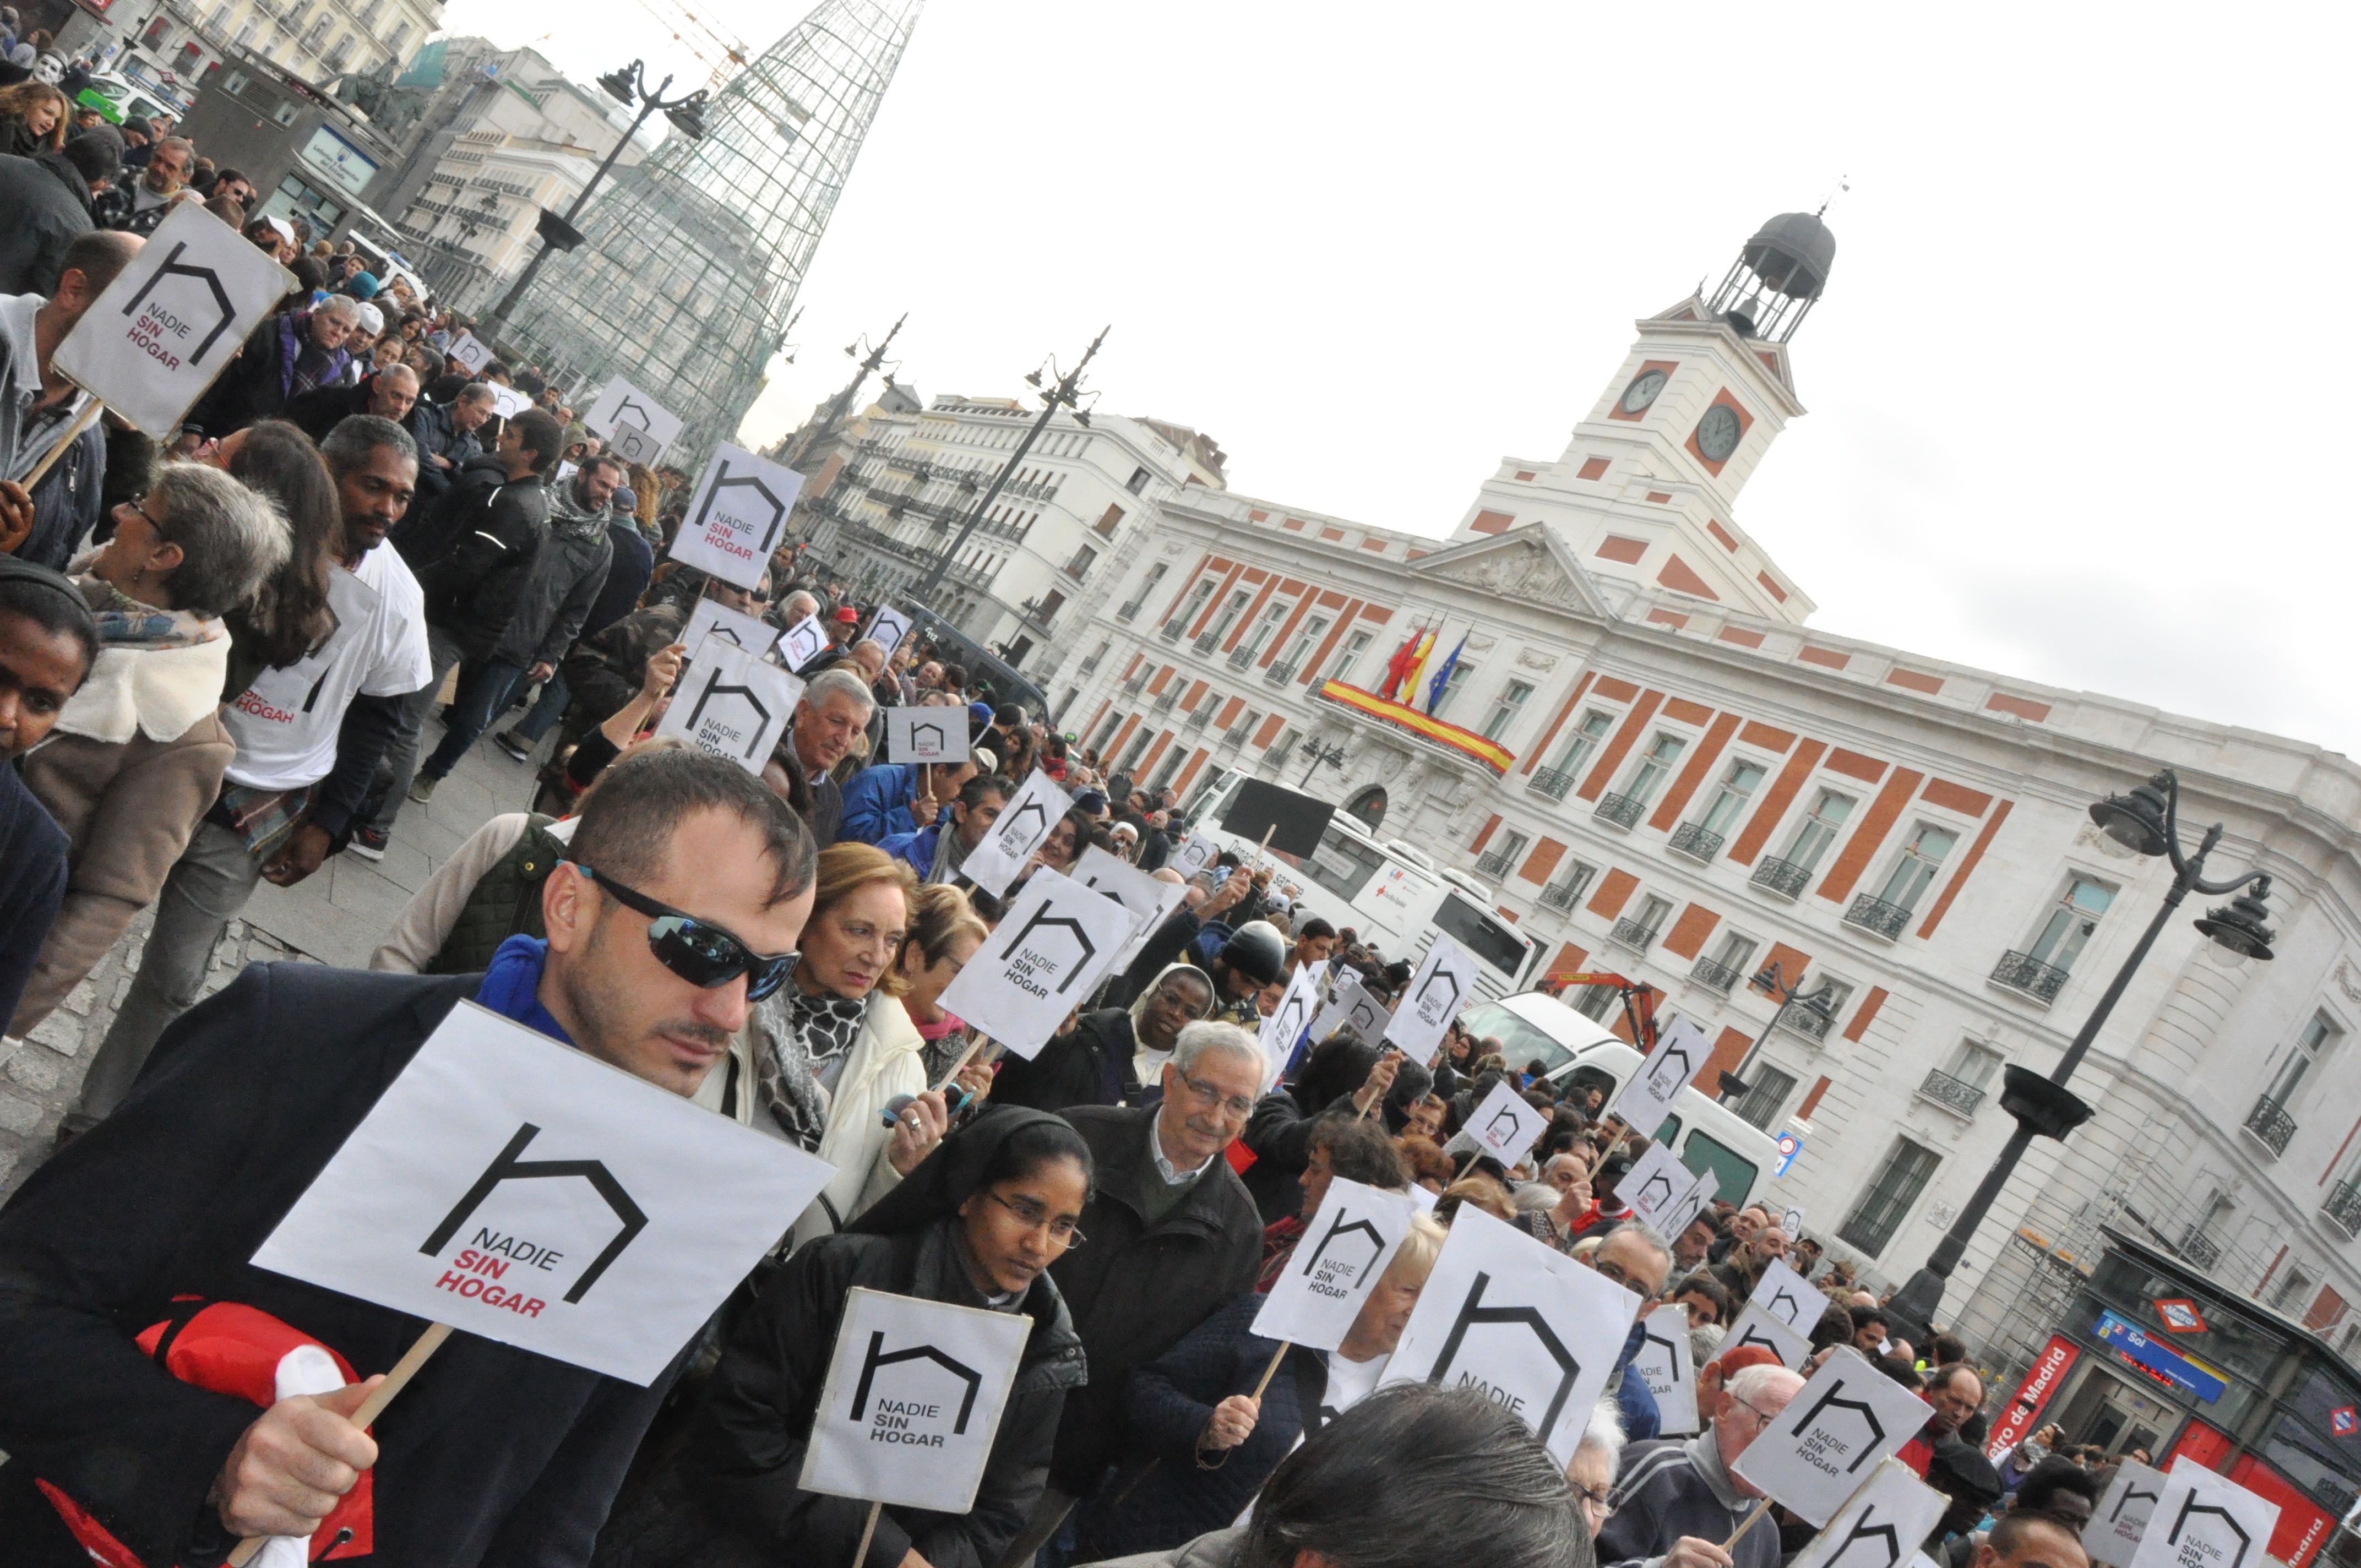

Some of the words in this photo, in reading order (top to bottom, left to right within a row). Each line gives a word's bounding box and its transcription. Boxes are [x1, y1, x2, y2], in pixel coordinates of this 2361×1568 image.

[137, 315, 164, 338] SIN
[146, 302, 191, 339] NADIE
[126, 327, 180, 371] HOGAR
[710, 522, 733, 538] SIN
[714, 511, 755, 535] NADIE
[704, 532, 753, 560] HOGAR
[699, 728, 721, 745] SIN
[704, 717, 742, 743] NADIE
[1003, 834, 1015, 846] SIN
[1011, 826, 1028, 843] NADIE
[998, 842, 1018, 861] HOGAR
[1012, 959, 1035, 976] SIN
[1020, 948, 1058, 974] NADIE
[1004, 968, 1048, 1000] HOGAR
[1421, 1001, 1432, 1012] SIN
[1424, 993, 1443, 1011] NADIE
[1417, 1009, 1437, 1028] HOGAR
[1652, 1079, 1662, 1089] SIN
[1647, 1085, 1665, 1104] HOGAR
[1486, 1135, 1500, 1149] HOGAR
[1637, 1199, 1652, 1216] HOGAR
[471, 1227, 564, 1272] NADIE
[454, 1249, 511, 1280] SIN
[1320, 1257, 1356, 1277] NADIE
[1314, 1270, 1336, 1284] SIN
[434, 1269, 546, 1319] HOGAR
[1308, 1281, 1348, 1300] HOGAR
[2165, 1304, 2193, 1326] Metro
[2127, 1331, 2147, 1348] Sol
[1640, 1366, 1663, 1376] ADIE
[878, 1398, 940, 1418] NADIE
[1988, 1427, 2014, 1459] etro
[2010, 1404, 2029, 1426] de
[2022, 1346, 2066, 1404] Madrid
[873, 1413, 910, 1430] SIN
[869, 1428, 945, 1448] HOGAR
[1804, 1438, 1827, 1455] SIN
[1811, 1428, 1849, 1455] NADIE
[1796, 1445, 1839, 1477] HOGAR
[2118, 1521, 2133, 1531] SIN
[2181, 1544, 2203, 1561] SIN
[2185, 1534, 2223, 1561] NADIE
